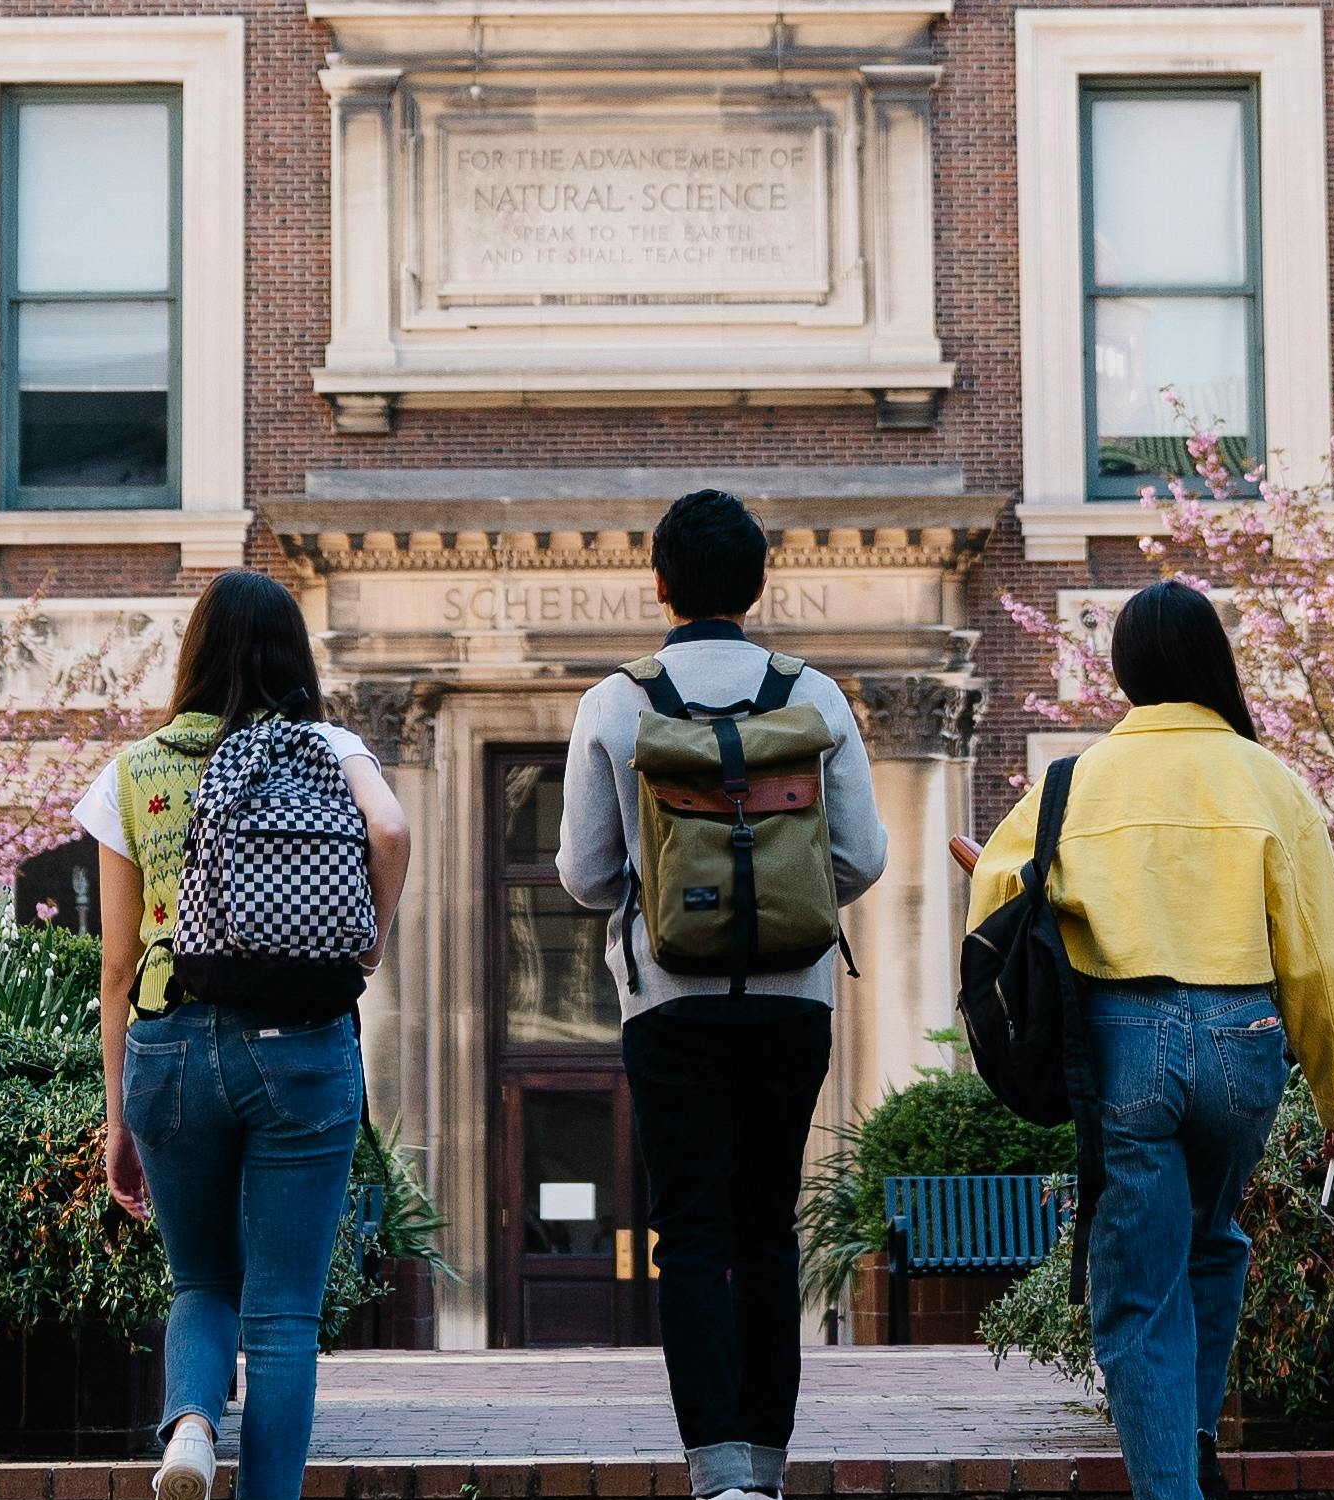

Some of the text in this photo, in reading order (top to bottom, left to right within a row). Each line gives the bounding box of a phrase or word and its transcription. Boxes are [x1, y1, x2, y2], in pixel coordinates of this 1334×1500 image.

[457, 146, 805, 171] FOR THE ADVANCEMENT OF
[474, 182, 787, 213] NATURAL SCIENCE
[588, 224, 616, 242] TO
[627, 224, 670, 242] THE
[683, 223, 752, 243] EARTH
[480, 247, 524, 265] AND
[536, 247, 557, 265] IT
[566, 247, 634, 265] SHALL
[641, 246, 714, 264] TEACH
[442, 584, 829, 622] SCHERMERN
